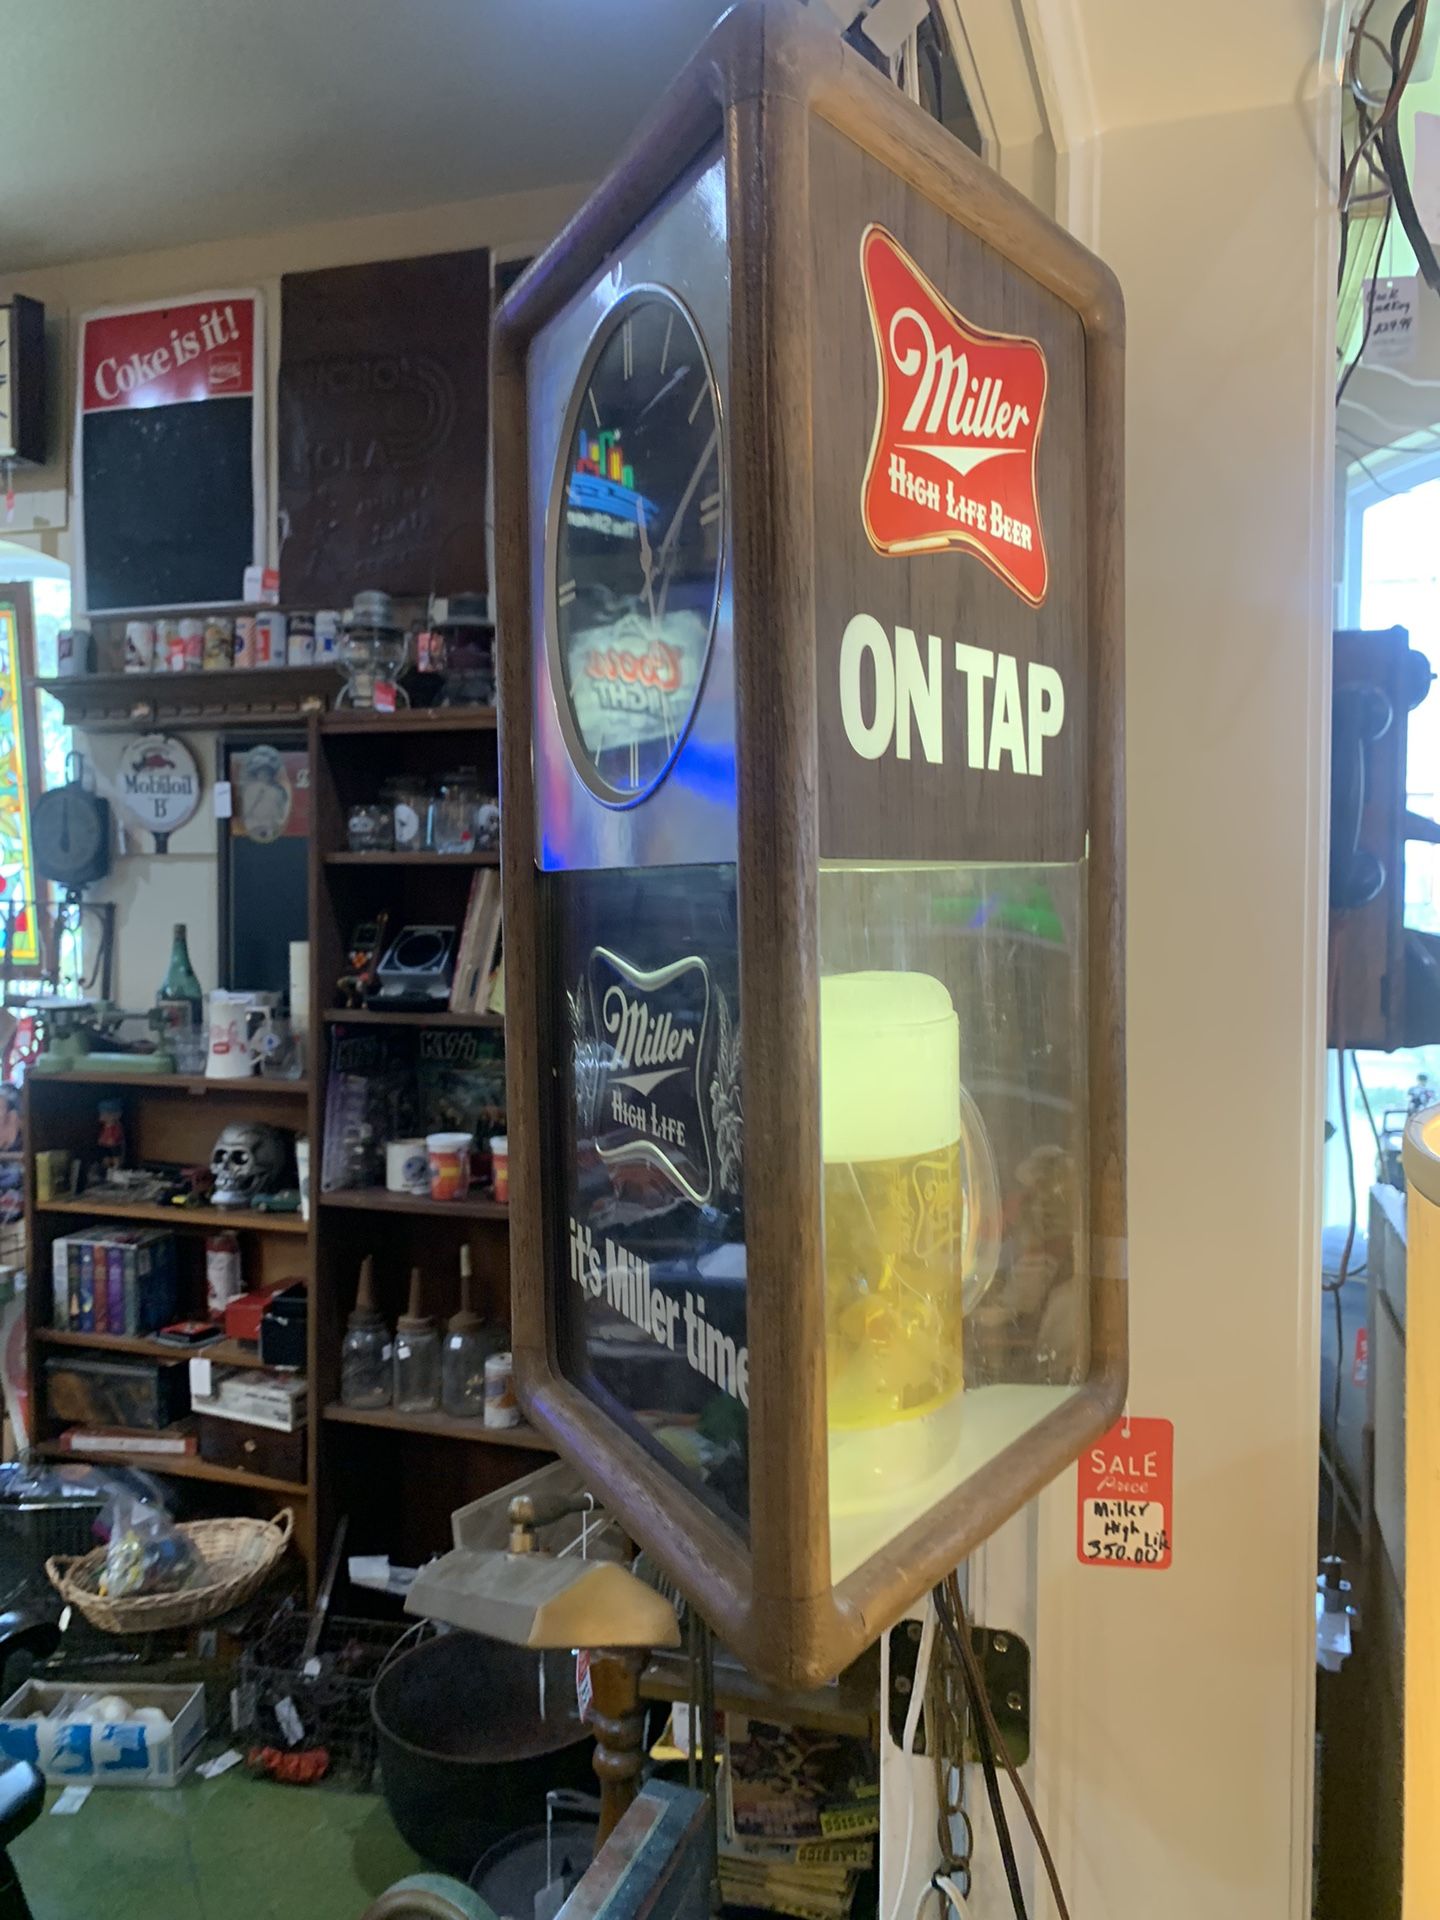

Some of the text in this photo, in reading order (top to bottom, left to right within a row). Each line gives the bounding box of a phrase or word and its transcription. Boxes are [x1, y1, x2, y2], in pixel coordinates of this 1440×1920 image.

[95, 304, 239, 400] Coke is it!
[889, 307, 1030, 440] Miller
[888, 453, 1033, 552] HIGH LIFE BEER
[839, 613, 1065, 776] ON TAP
[125, 774, 193, 795] Mobiloil
[154, 798, 167, 818] B
[603, 985, 695, 1072] Miller
[611, 1089, 687, 1148] HIGH LIFE
[570, 1216, 749, 1410] it's Miller time
[1091, 1449, 1158, 1478] SALE
[1087, 1539, 1159, 1564] 350.00
[1103, 1520, 1140, 1543] High
